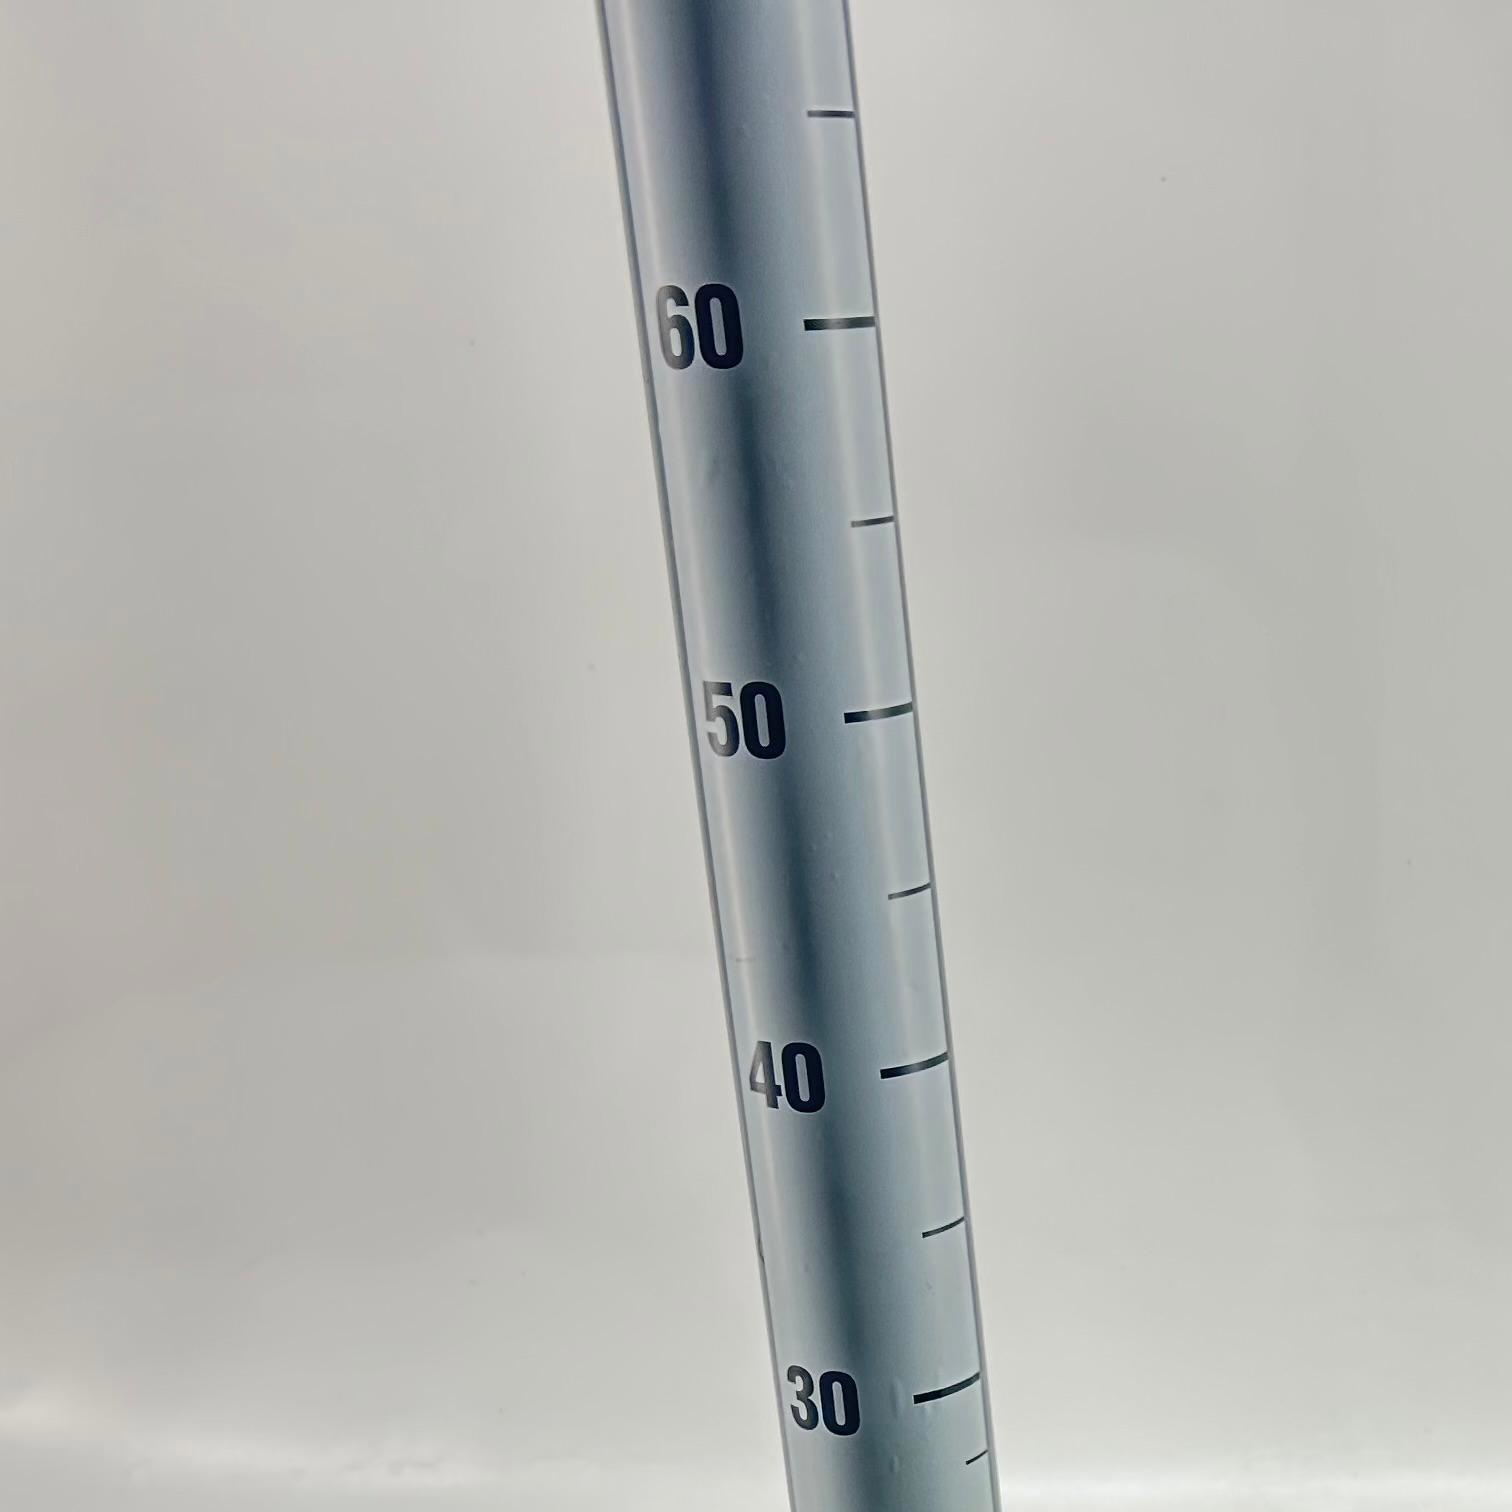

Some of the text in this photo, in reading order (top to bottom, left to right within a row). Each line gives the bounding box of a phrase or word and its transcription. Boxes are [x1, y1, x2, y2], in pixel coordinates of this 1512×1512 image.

[655, 283, 744, 370] 60
[702, 680, 787, 760] 50
[749, 1041, 826, 1114] 40
[786, 1365, 861, 1436] 30
